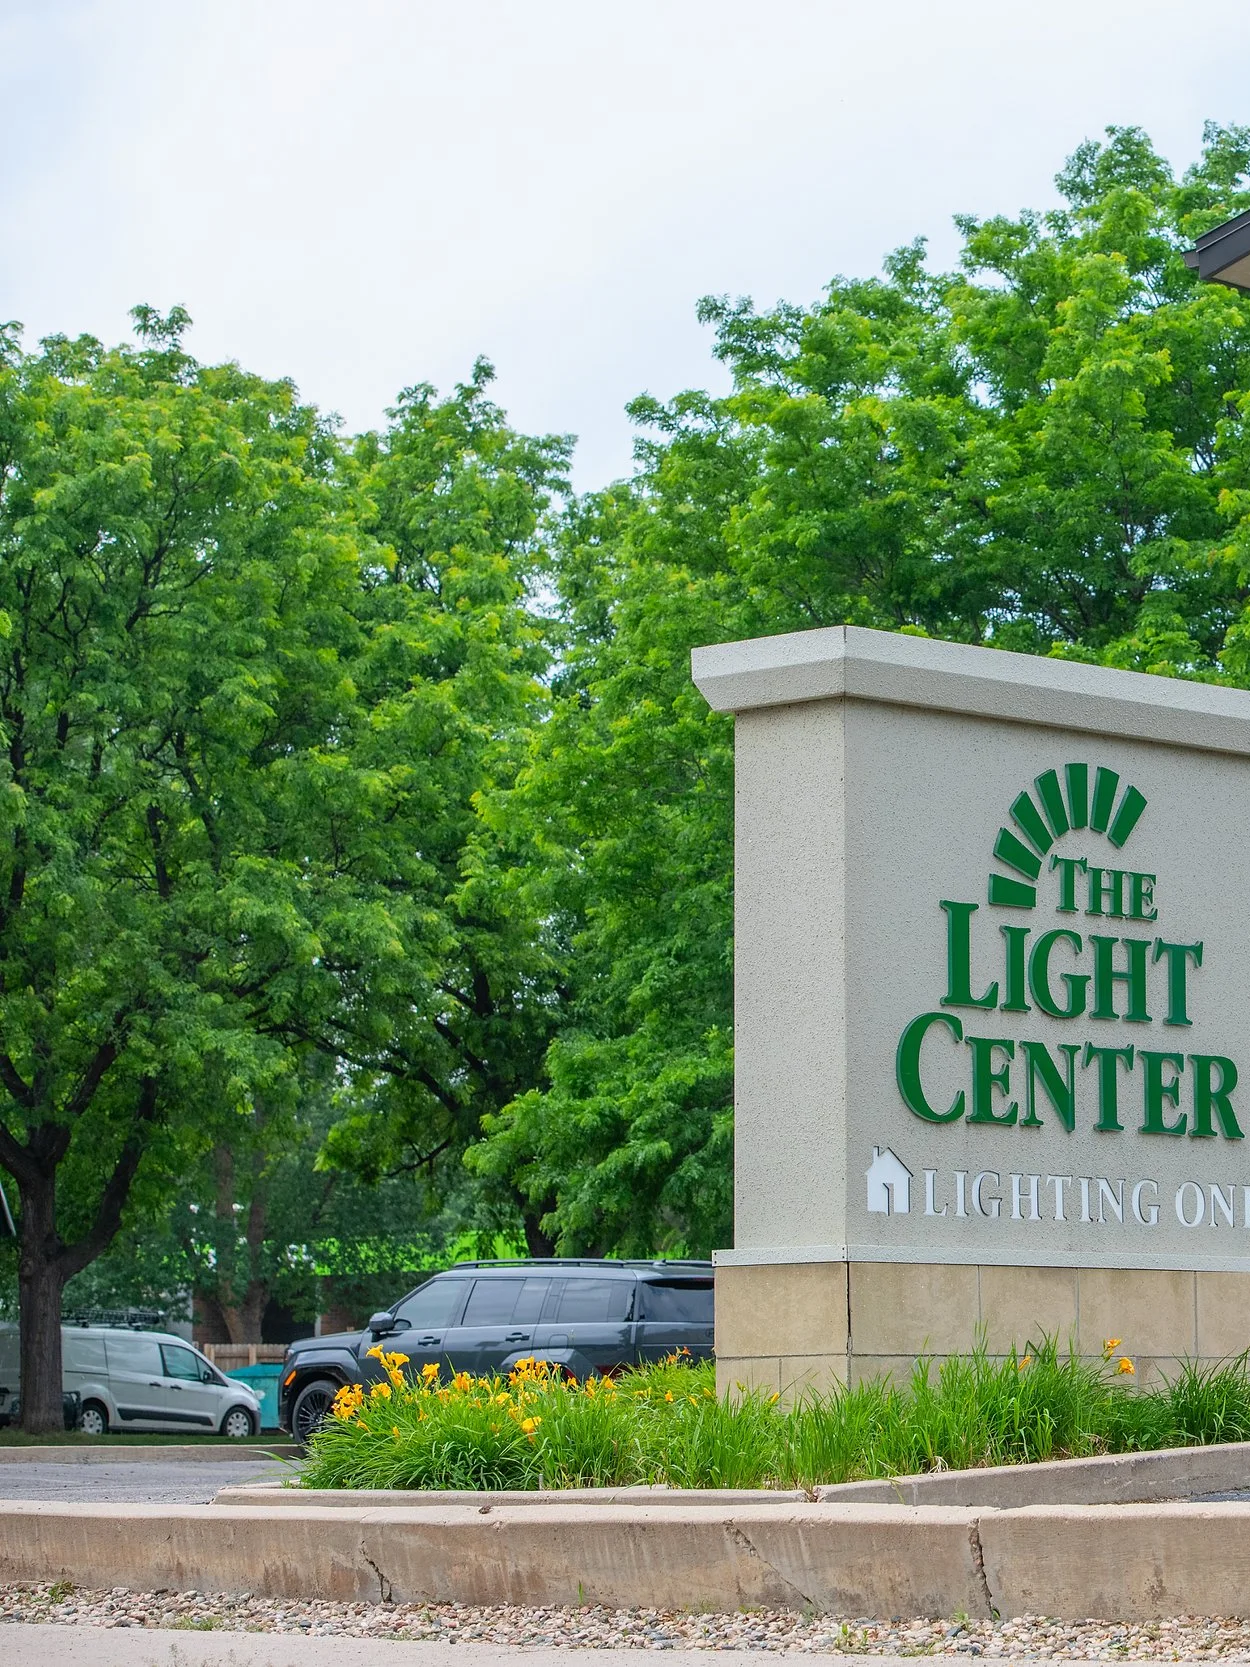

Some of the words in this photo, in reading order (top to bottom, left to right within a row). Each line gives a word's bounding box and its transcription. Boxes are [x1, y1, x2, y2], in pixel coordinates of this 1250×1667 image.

[1049, 854, 1158, 921] THE
[940, 899, 1203, 1026] LIGHT
[896, 1012, 1245, 1139] CENTER
[922, 1168, 1160, 1226] LIGHTING
